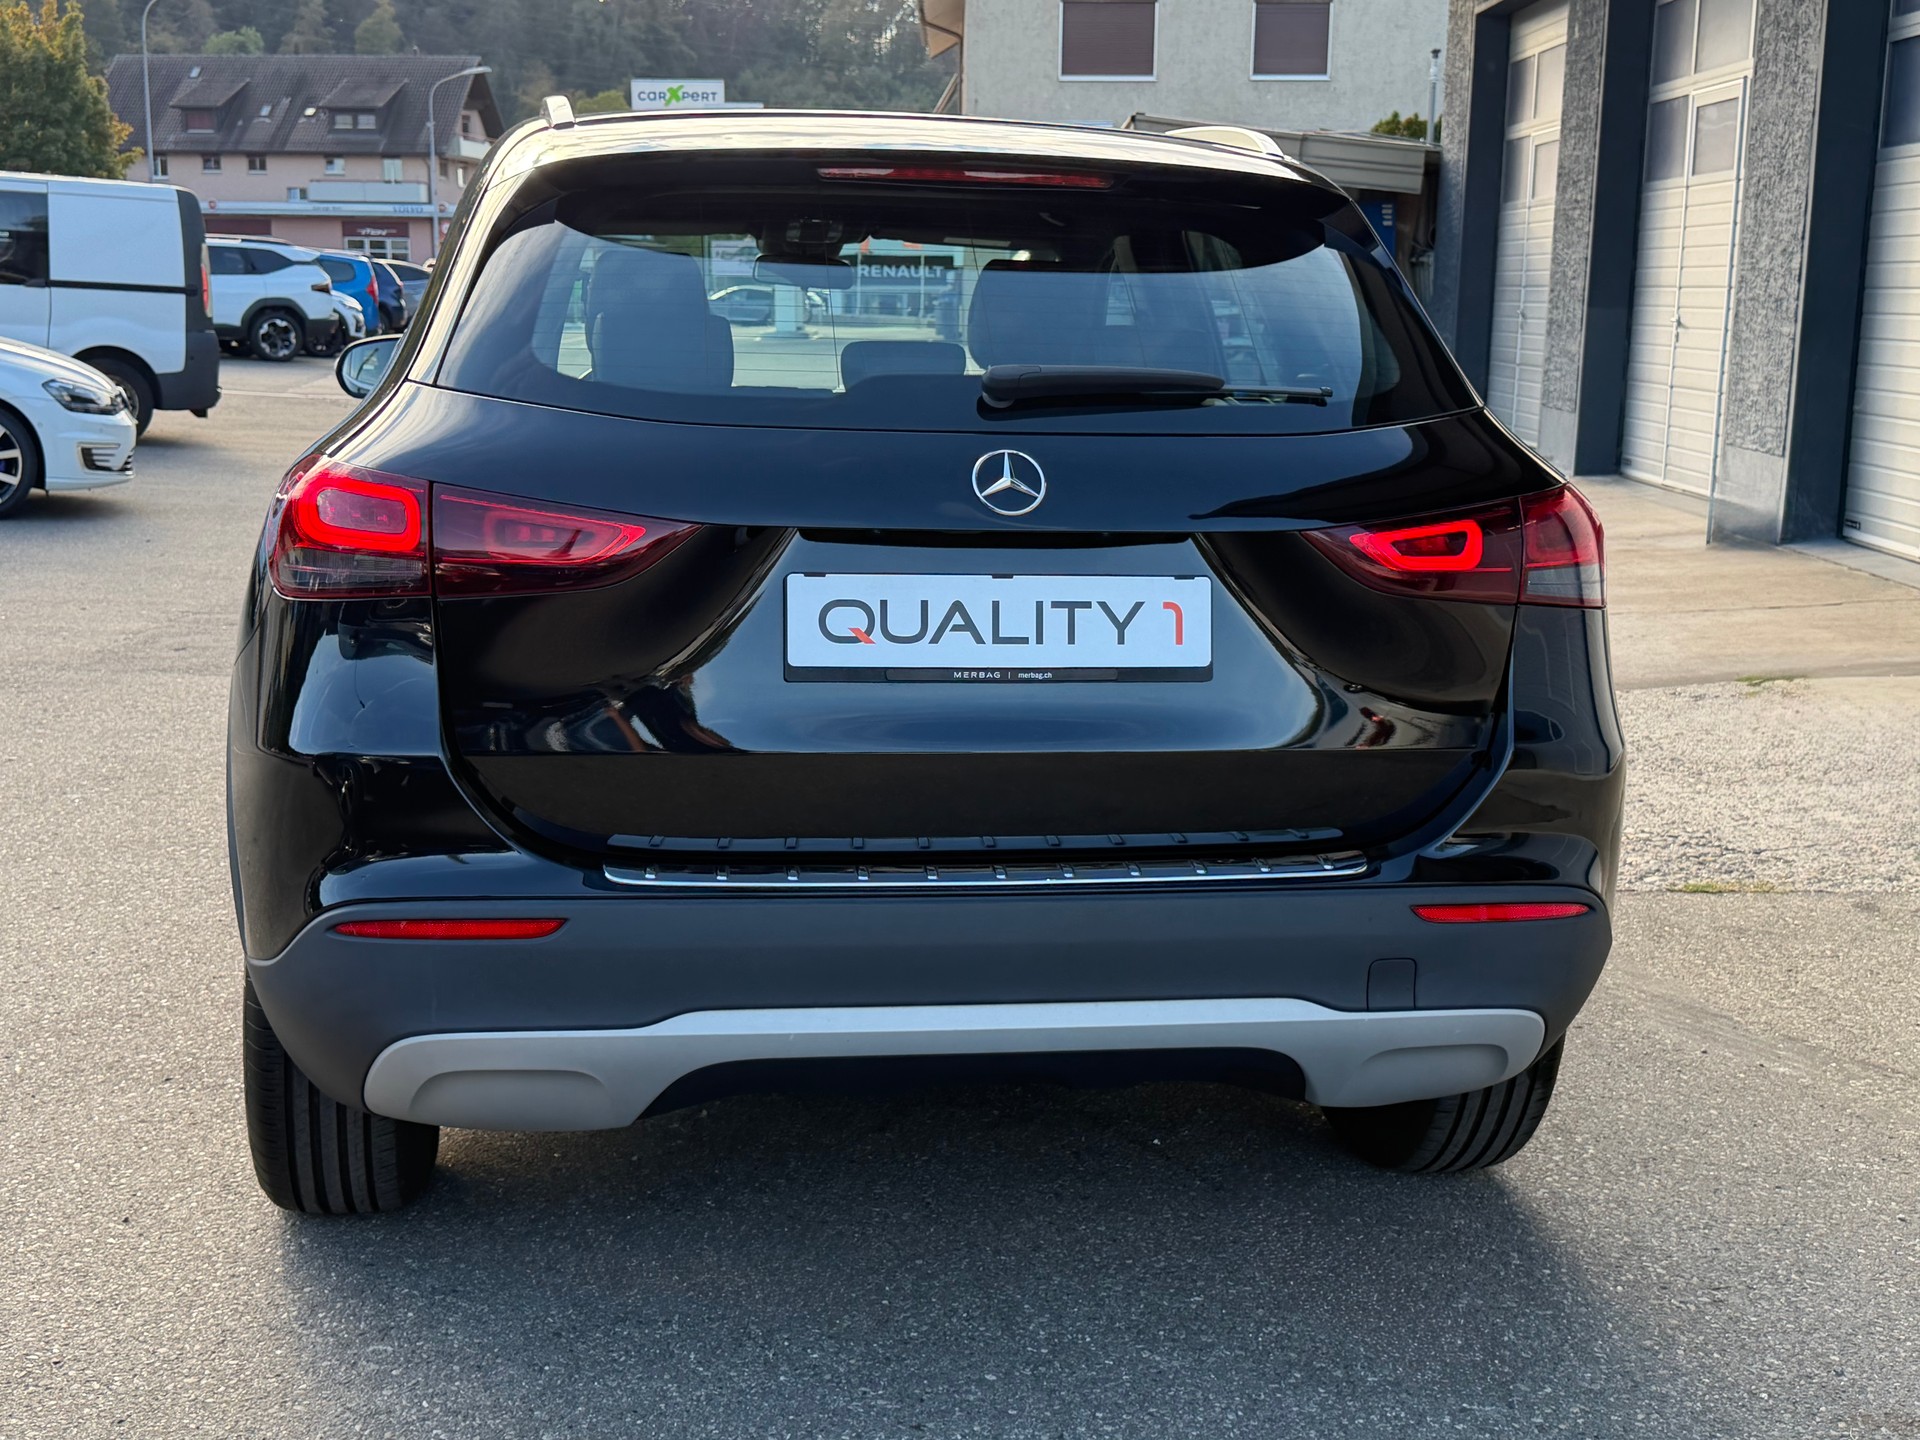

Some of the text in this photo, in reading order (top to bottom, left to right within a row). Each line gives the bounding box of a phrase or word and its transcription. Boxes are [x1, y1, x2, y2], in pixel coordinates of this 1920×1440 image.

[859, 264, 945, 279] RENAULT
[818, 598, 1184, 646] QUALITY 1
[953, 671, 1053, 680] MERBAG merbag.ch
